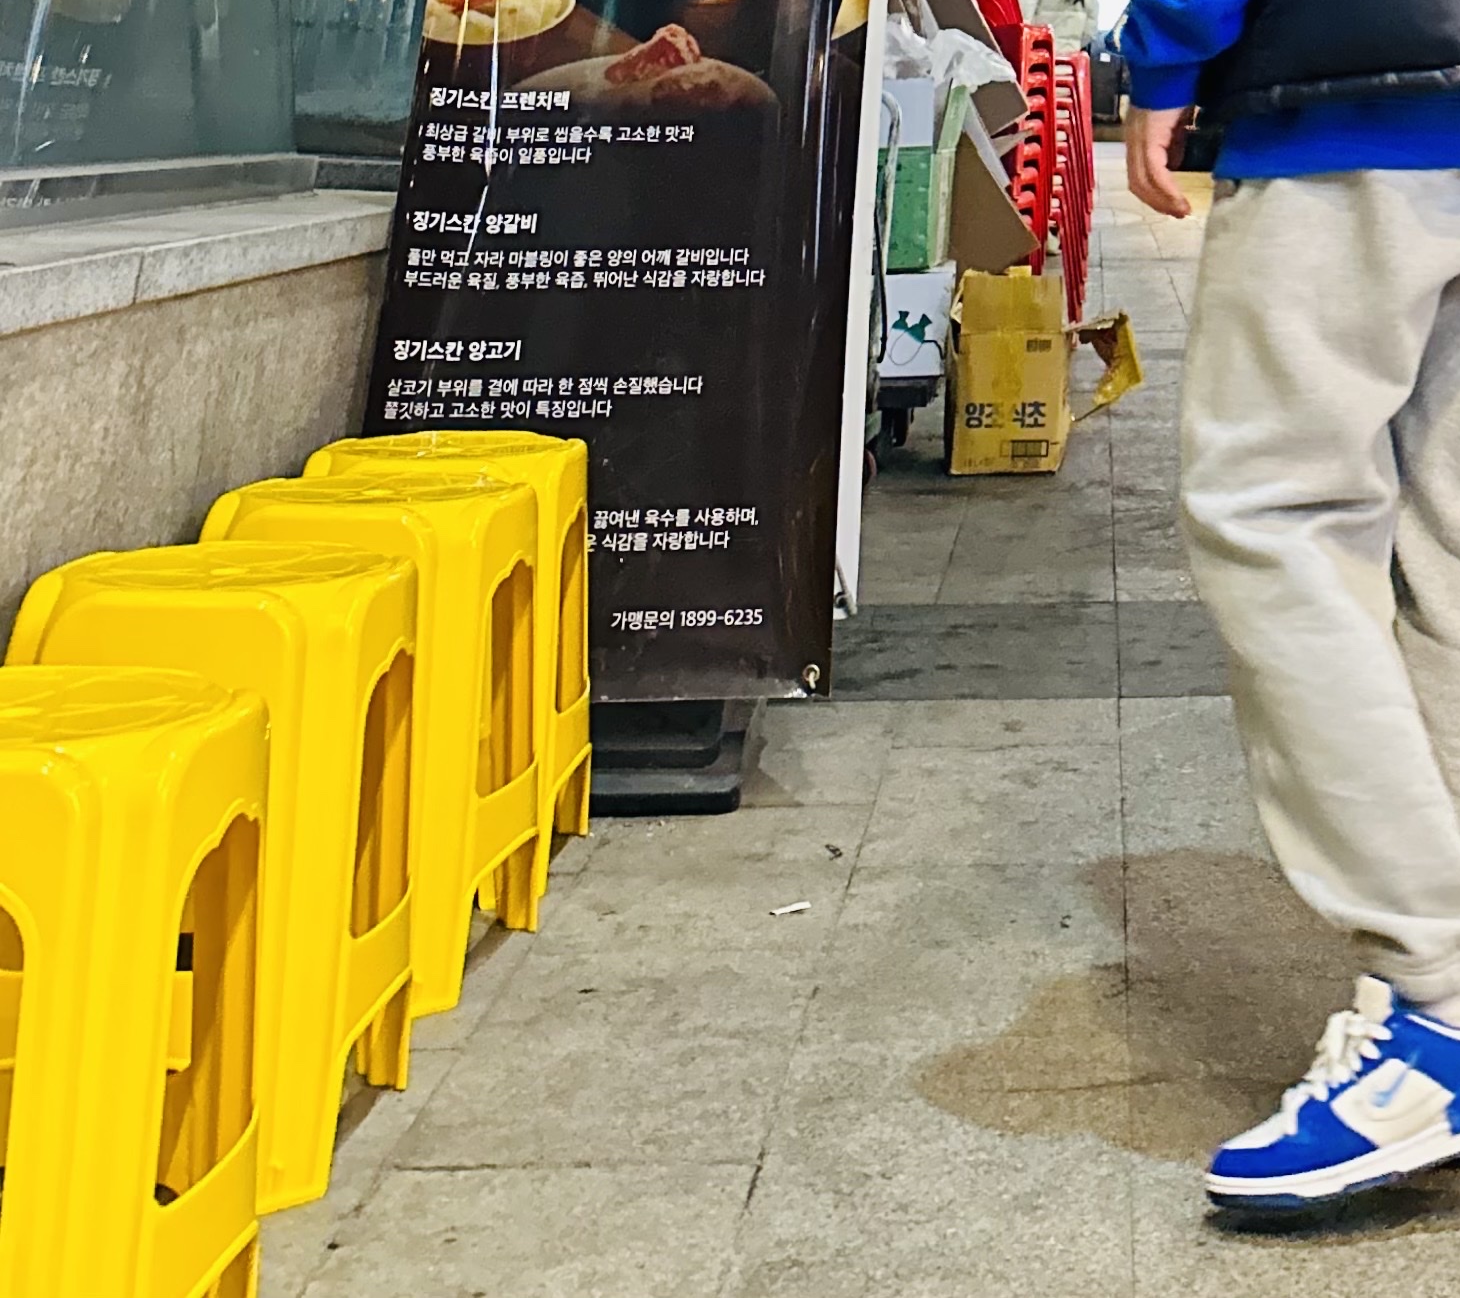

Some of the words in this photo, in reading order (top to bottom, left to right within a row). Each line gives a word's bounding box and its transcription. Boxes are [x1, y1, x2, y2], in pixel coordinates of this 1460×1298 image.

[430, 88, 497, 110] 징기스칸
[501, 91, 570, 110] 프렌치랙
[426, 124, 468, 141] 최상급
[473, 125, 500, 144] 갈비
[506, 127, 549, 143] 부위로
[554, 126, 612, 143] 씹을수록
[617, 126, 661, 143] 고소한
[666, 126, 694, 142] 맛과
[423, 145, 466, 162] 풍부한
[518, 147, 591, 163] 일품입니다
[413, 212, 479, 233] 징기스칸
[485, 213, 537, 234] 양갈비
[408, 249, 436, 266] 풀만
[441, 250, 470, 267] 먹고
[475, 250, 504, 267] 자라
[509, 250, 568, 267] 마블링이
[574, 250, 602, 267] 좋은
[607, 250, 636, 267] 양의
[642, 249, 671, 266] 어깨
[677, 249, 748, 267] 갈비입니다
[405, 271, 462, 289] 부드러운
[505, 272, 550, 289] 풍부한
[594, 270, 637, 288] 뛰어난
[643, 270, 687, 288] 식감을
[691, 269, 765, 287] 자랑합니다
[393, 340, 464, 362] 징기스칸
[469, 340, 521, 361] 양고기
[387, 379, 432, 397] 살코기
[437, 379, 481, 398] 부위를
[488, 379, 517, 397] 결에
[523, 378, 553, 396] 따라
[559, 377, 573, 396] 한
[579, 377, 608, 396] 점씩
[613, 376, 703, 395] 손질했습니다
[384, 400, 444, 420] 쫄깃하고
[450, 400, 495, 419] 고소한
[501, 400, 530, 418] 맛이
[536, 400, 611, 419] 특징입니다
[594, 508, 640, 529] 끓여낸
[645, 508, 689, 528] 육수를
[695, 507, 758, 527] 사용하며,
[602, 533, 648, 552] 식감을
[653, 531, 729, 550] 자랑합니다
[611, 610, 674, 631] 가맹문의
[680, 609, 763, 628] 1899-6235
